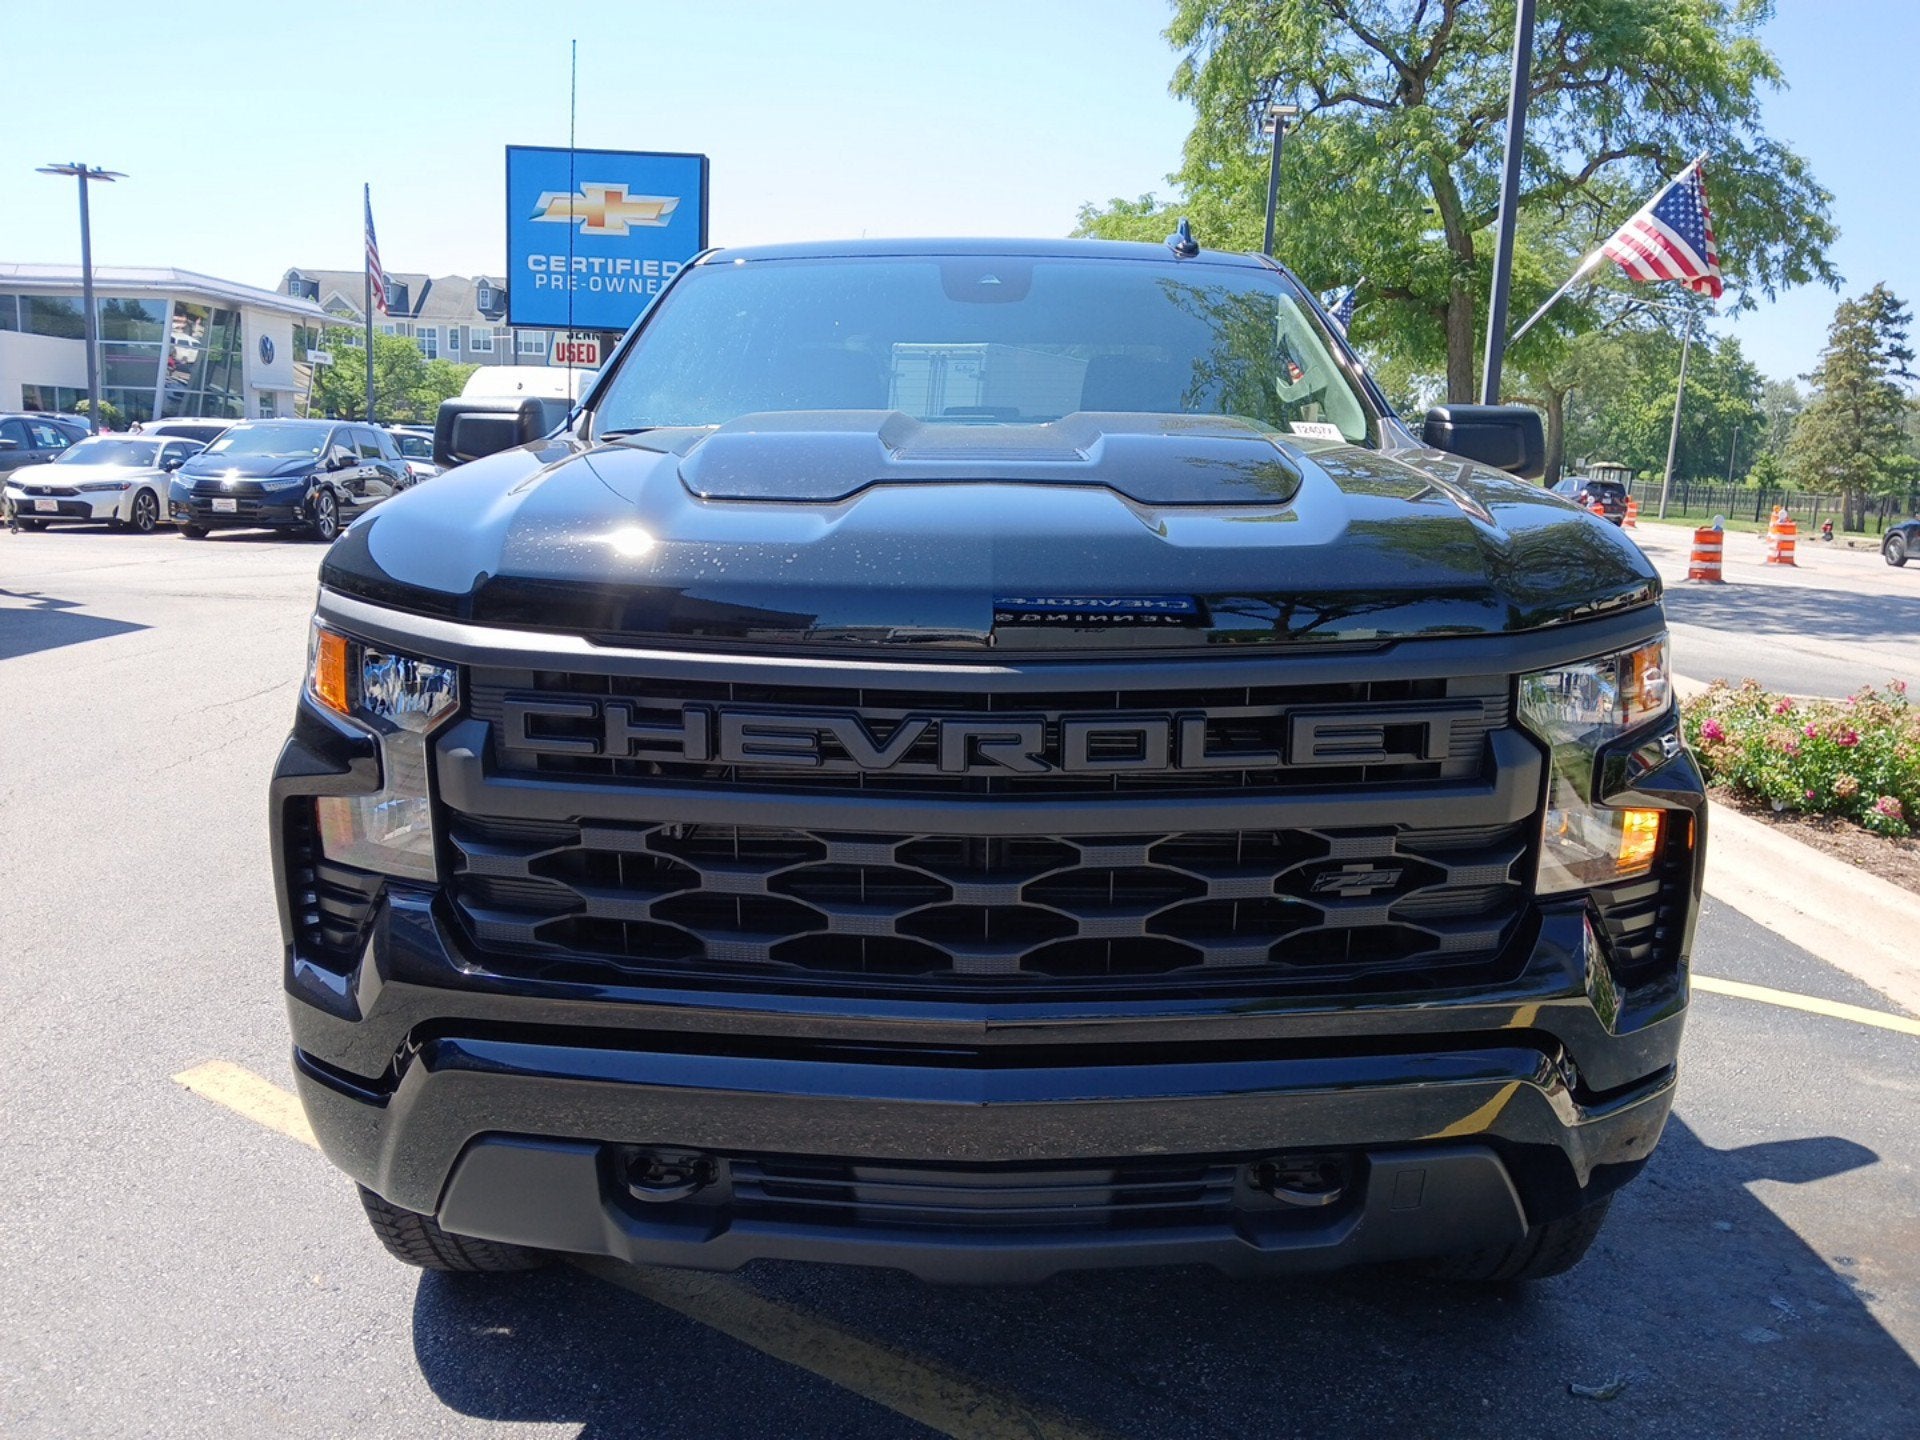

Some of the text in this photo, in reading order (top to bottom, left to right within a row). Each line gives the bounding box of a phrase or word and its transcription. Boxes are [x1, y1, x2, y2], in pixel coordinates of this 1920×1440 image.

[527, 254, 682, 277] CERTIFIED
[556, 342, 596, 363] USED
[503, 693, 1484, 774] CHEVROLET
